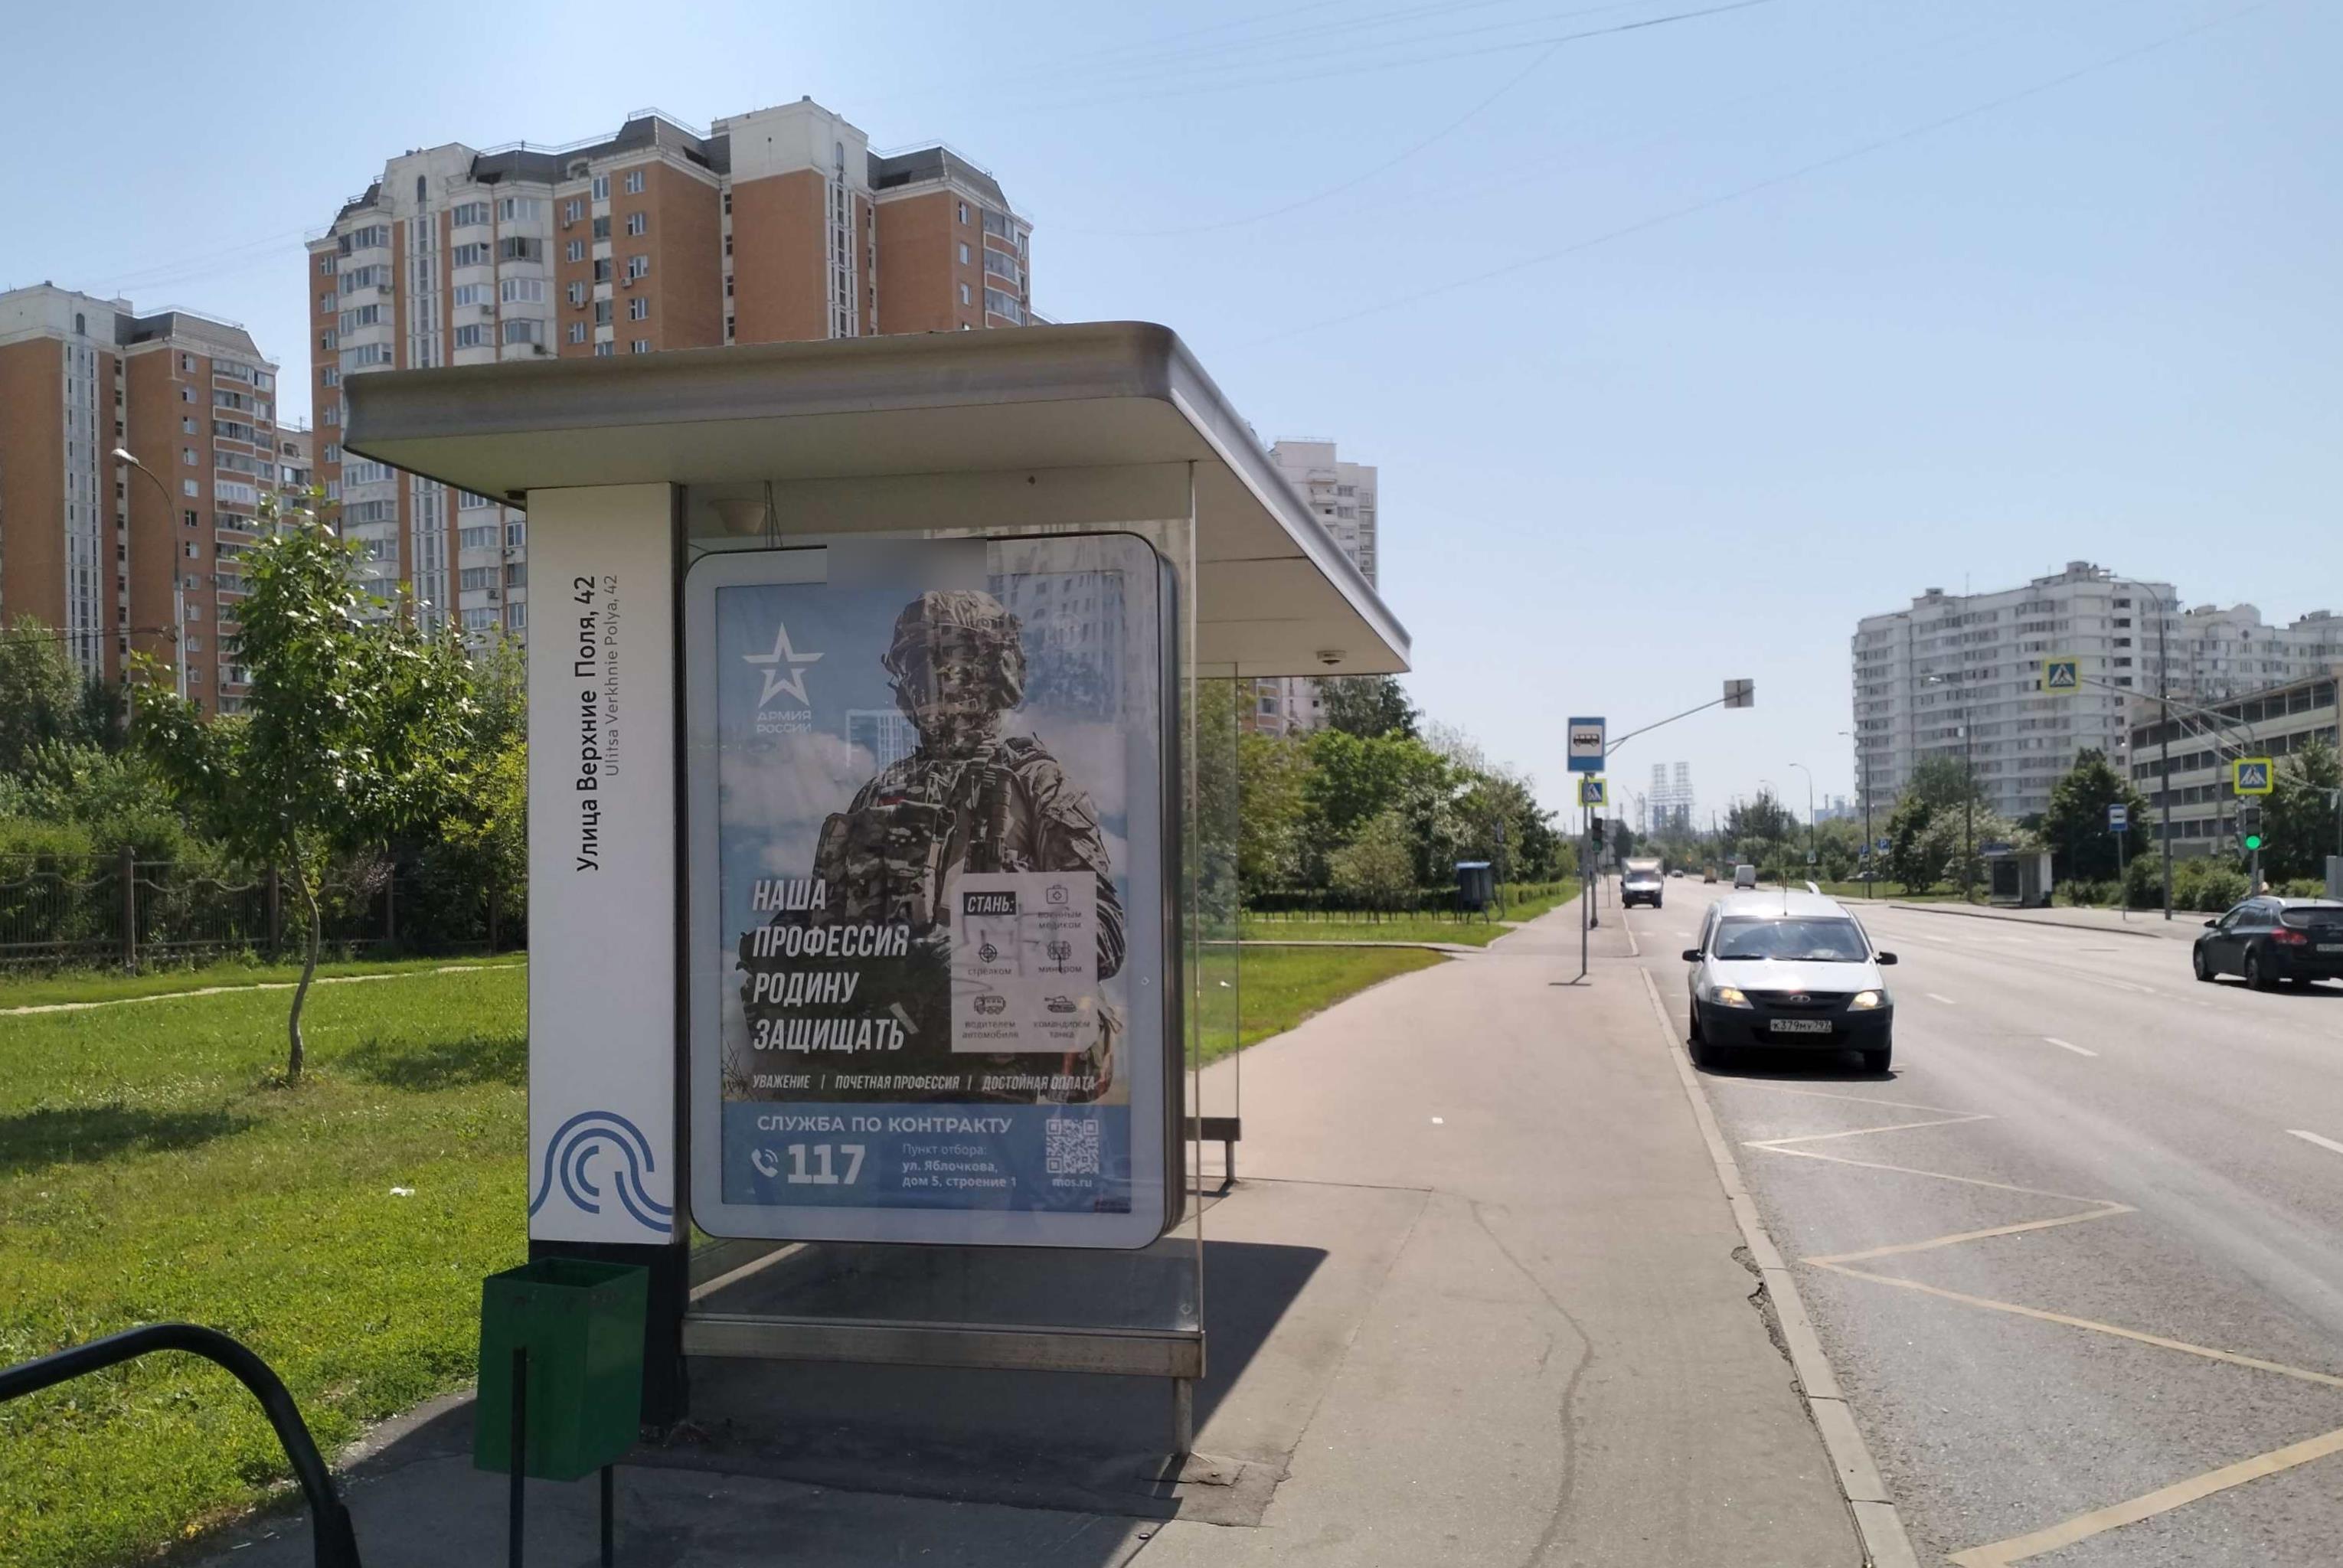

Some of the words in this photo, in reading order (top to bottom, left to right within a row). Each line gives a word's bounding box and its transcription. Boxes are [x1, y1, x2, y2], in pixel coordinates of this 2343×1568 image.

[573, 576, 596, 605] 42
[603, 575, 618, 596] 42
[604, 599, 621, 647] Polya,
[574, 610, 600, 678] Поля,
[603, 651, 619, 724] Verkhnie
[756, 710, 812, 722] АРМИЯ
[756, 724, 812, 734] РОССИИ
[577, 690, 603, 792] Верхние
[604, 729, 619, 776] Ulitsa
[577, 799, 602, 872] Улица
[752, 879, 827, 911] НАША
[967, 895, 1016, 914] СТАНЬ:
[752, 925, 910, 958] ПРОФЕССИЯ
[752, 972, 860, 1008] РОДИНУ
[753, 1018, 905, 1054] ЗАЩИЩАТЬ
[753, 1074, 810, 1089] УВАЖЕНИЕ
[835, 1075, 890, 1089] ПОЧЕТНАЯ
[893, 1075, 959, 1089] ПРОФЕССИЯ
[982, 1073, 1048, 1091] ДОСТОЙНАЯ
[757, 1116, 845, 1132] СЛУЖБА
[851, 1117, 881, 1132] ПО
[888, 1117, 1013, 1134] КОНТРАКТУ
[787, 1143, 866, 1185] 117
[902, 1143, 939, 1157] Пункт
[941, 1144, 988, 1157] отбора:
[902, 1163, 921, 1174] ул.
[924, 1160, 998, 1174] Яблочкова,
[1051, 1177, 1093, 1187] mos.ru
[902, 1176, 930, 1188] дом
[931, 1175, 943, 1188] 5,
[946, 1177, 1007, 1190] строение
[1009, 1176, 1018, 1187] 1
